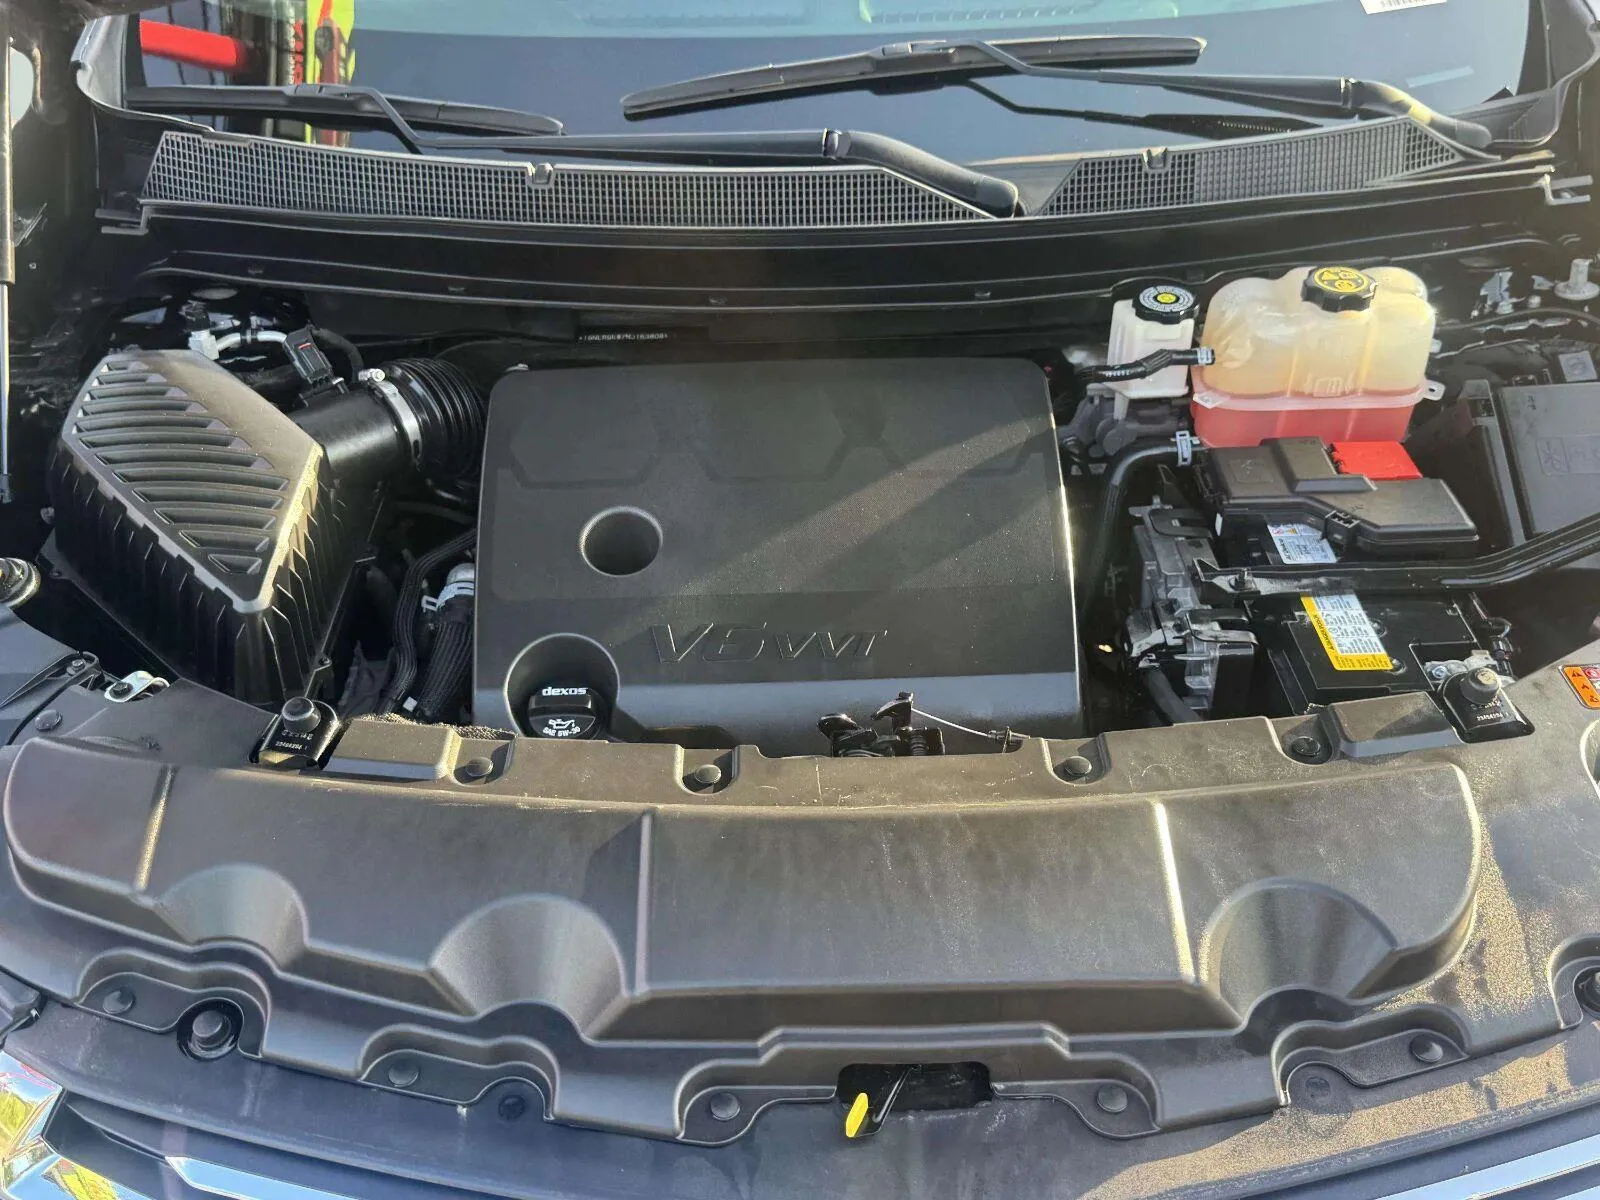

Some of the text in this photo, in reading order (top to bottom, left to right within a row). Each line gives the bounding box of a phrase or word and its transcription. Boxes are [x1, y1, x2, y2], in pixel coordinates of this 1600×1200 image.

[650, 622, 888, 664] V6 VVT
[541, 686, 588, 696] dexos
[543, 726, 556, 737] SAE
